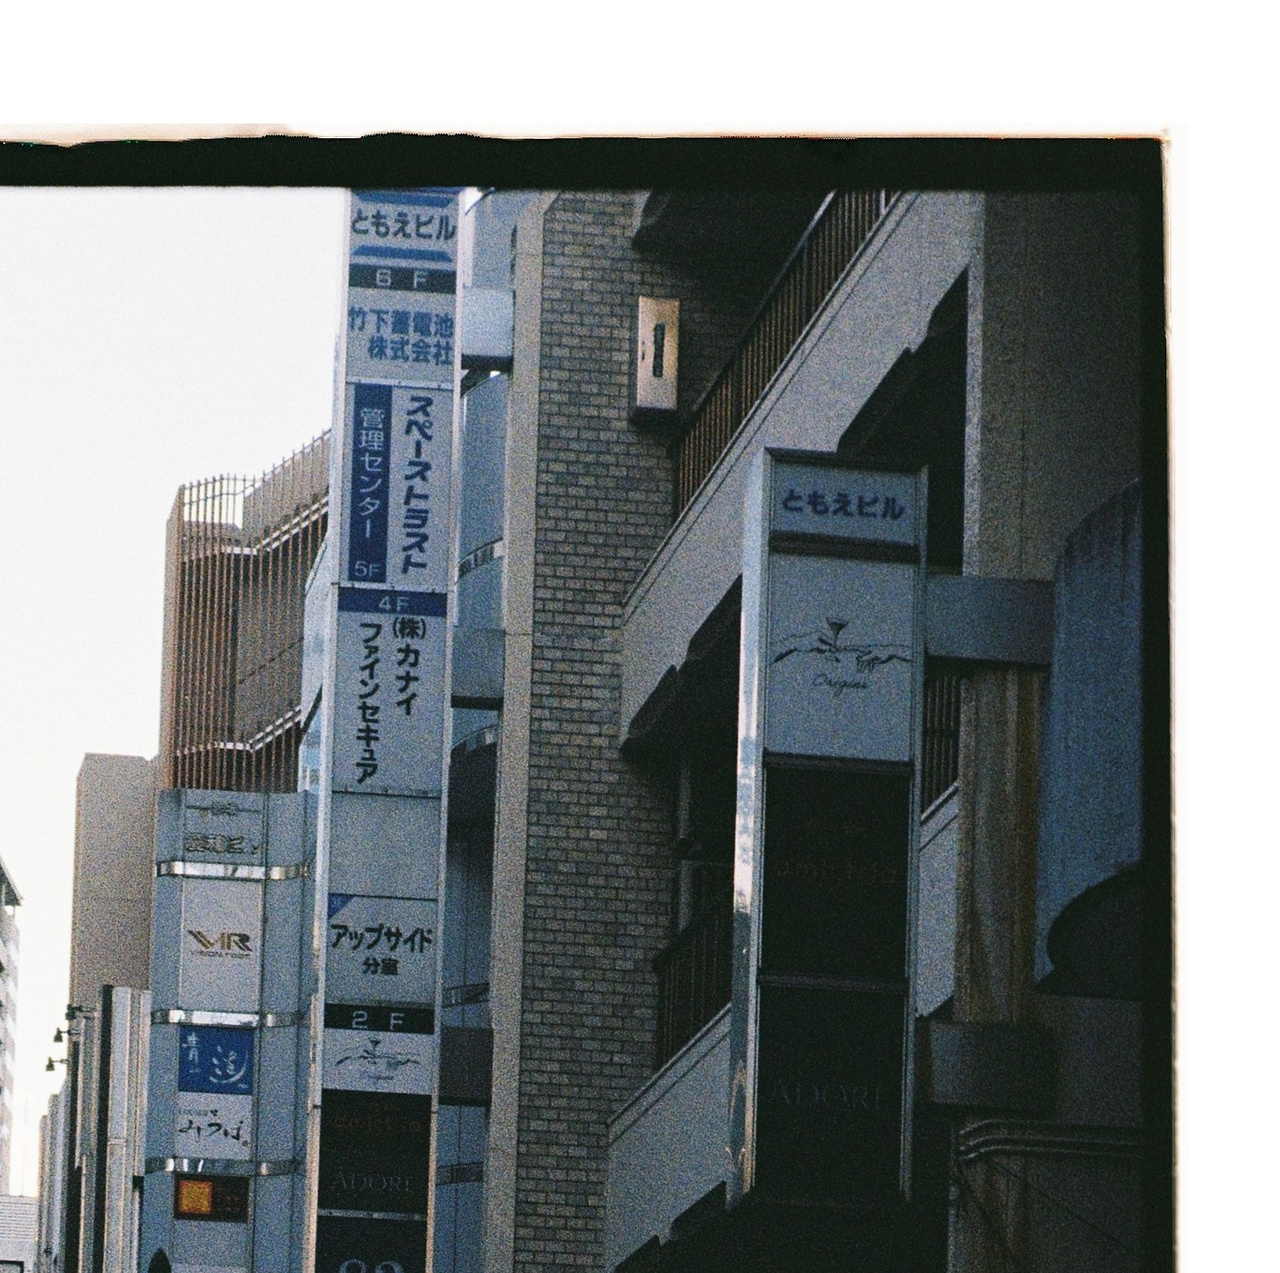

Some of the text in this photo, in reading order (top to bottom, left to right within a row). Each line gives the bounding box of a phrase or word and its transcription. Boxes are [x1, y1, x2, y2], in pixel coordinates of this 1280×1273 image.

[352, 208, 456, 242] ともえビル
[367, 335, 454, 366] 株式会社
[359, 407, 385, 538] 管理センター
[401, 395, 434, 575] スペーストラスト
[781, 488, 906, 520] ともえビル
[354, 560, 380, 579] 5F
[378, 595, 409, 611] 4F
[355, 622, 383, 784] ファインセキュア
[331, 922, 433, 955] アップサイド
[361, 957, 399, 977] 分室
